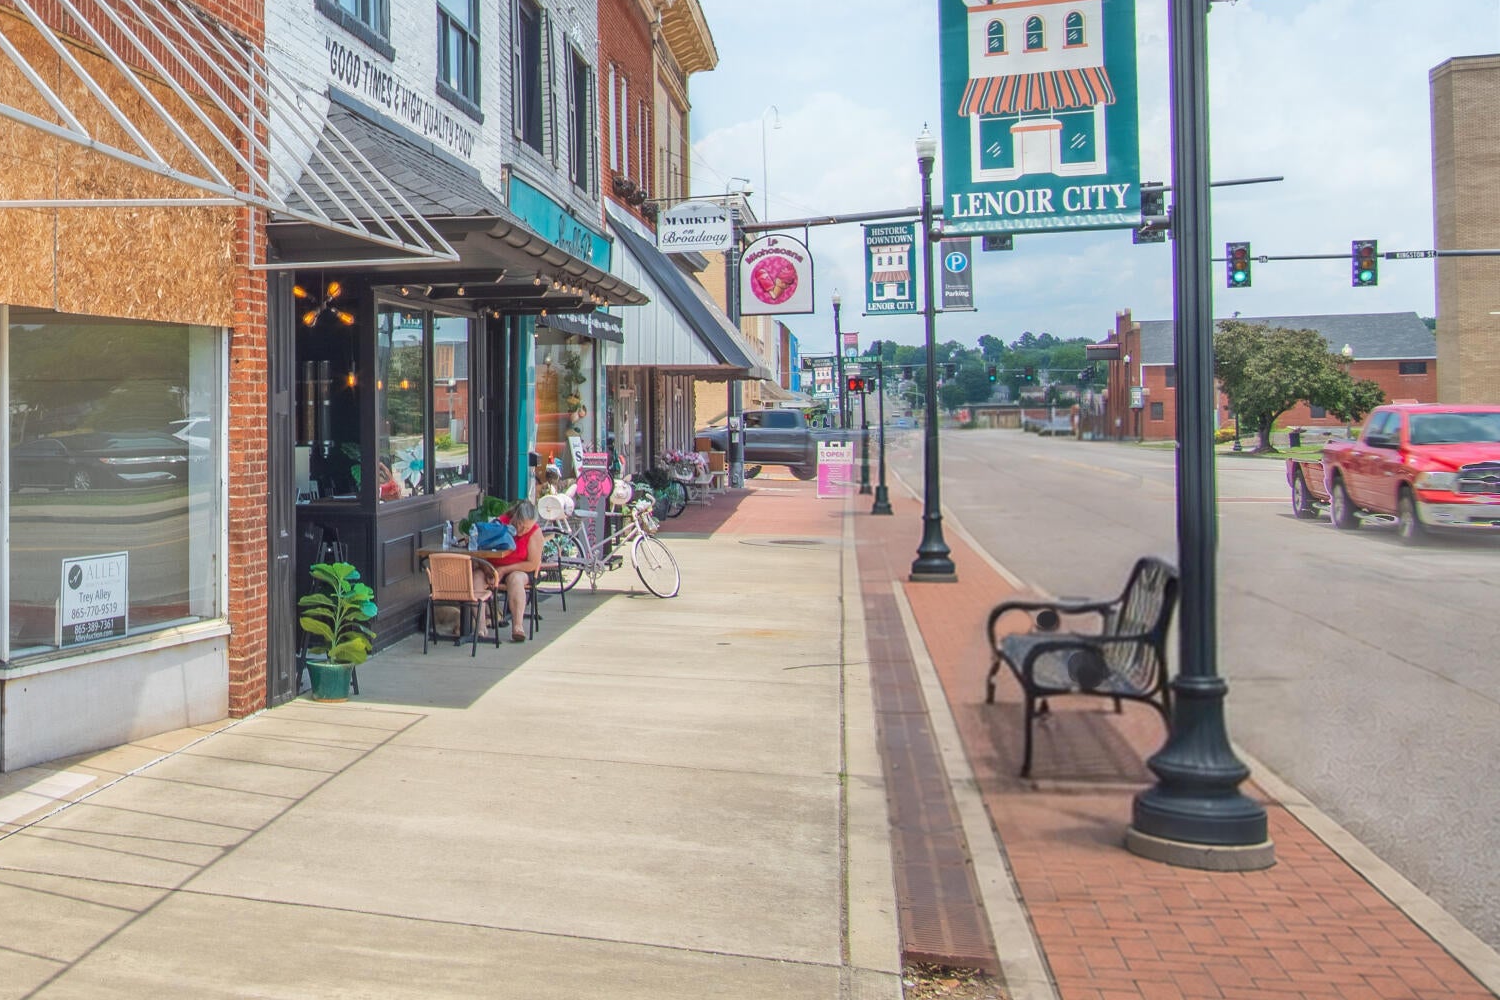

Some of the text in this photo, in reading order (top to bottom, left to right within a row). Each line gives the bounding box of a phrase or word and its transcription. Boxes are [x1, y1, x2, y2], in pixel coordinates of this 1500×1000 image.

[363, 60, 393, 109] TIMES
[401, 87, 423, 127] HIGH
[423, 102, 454, 147] QUALITY
[951, 183, 1131, 218] LENOIR CITY
[665, 214, 727, 226] MARKETS
[871, 226, 908, 236] HISTORIC
[662, 230, 729, 246] Broadway
[866, 234, 913, 245] DOWNTOWN
[945, 289, 970, 297] Parking
[867, 301, 915, 311] LENOIR CITY
[86, 560, 123, 580] ALLEY
[79, 588, 112, 603] Trey Alley
